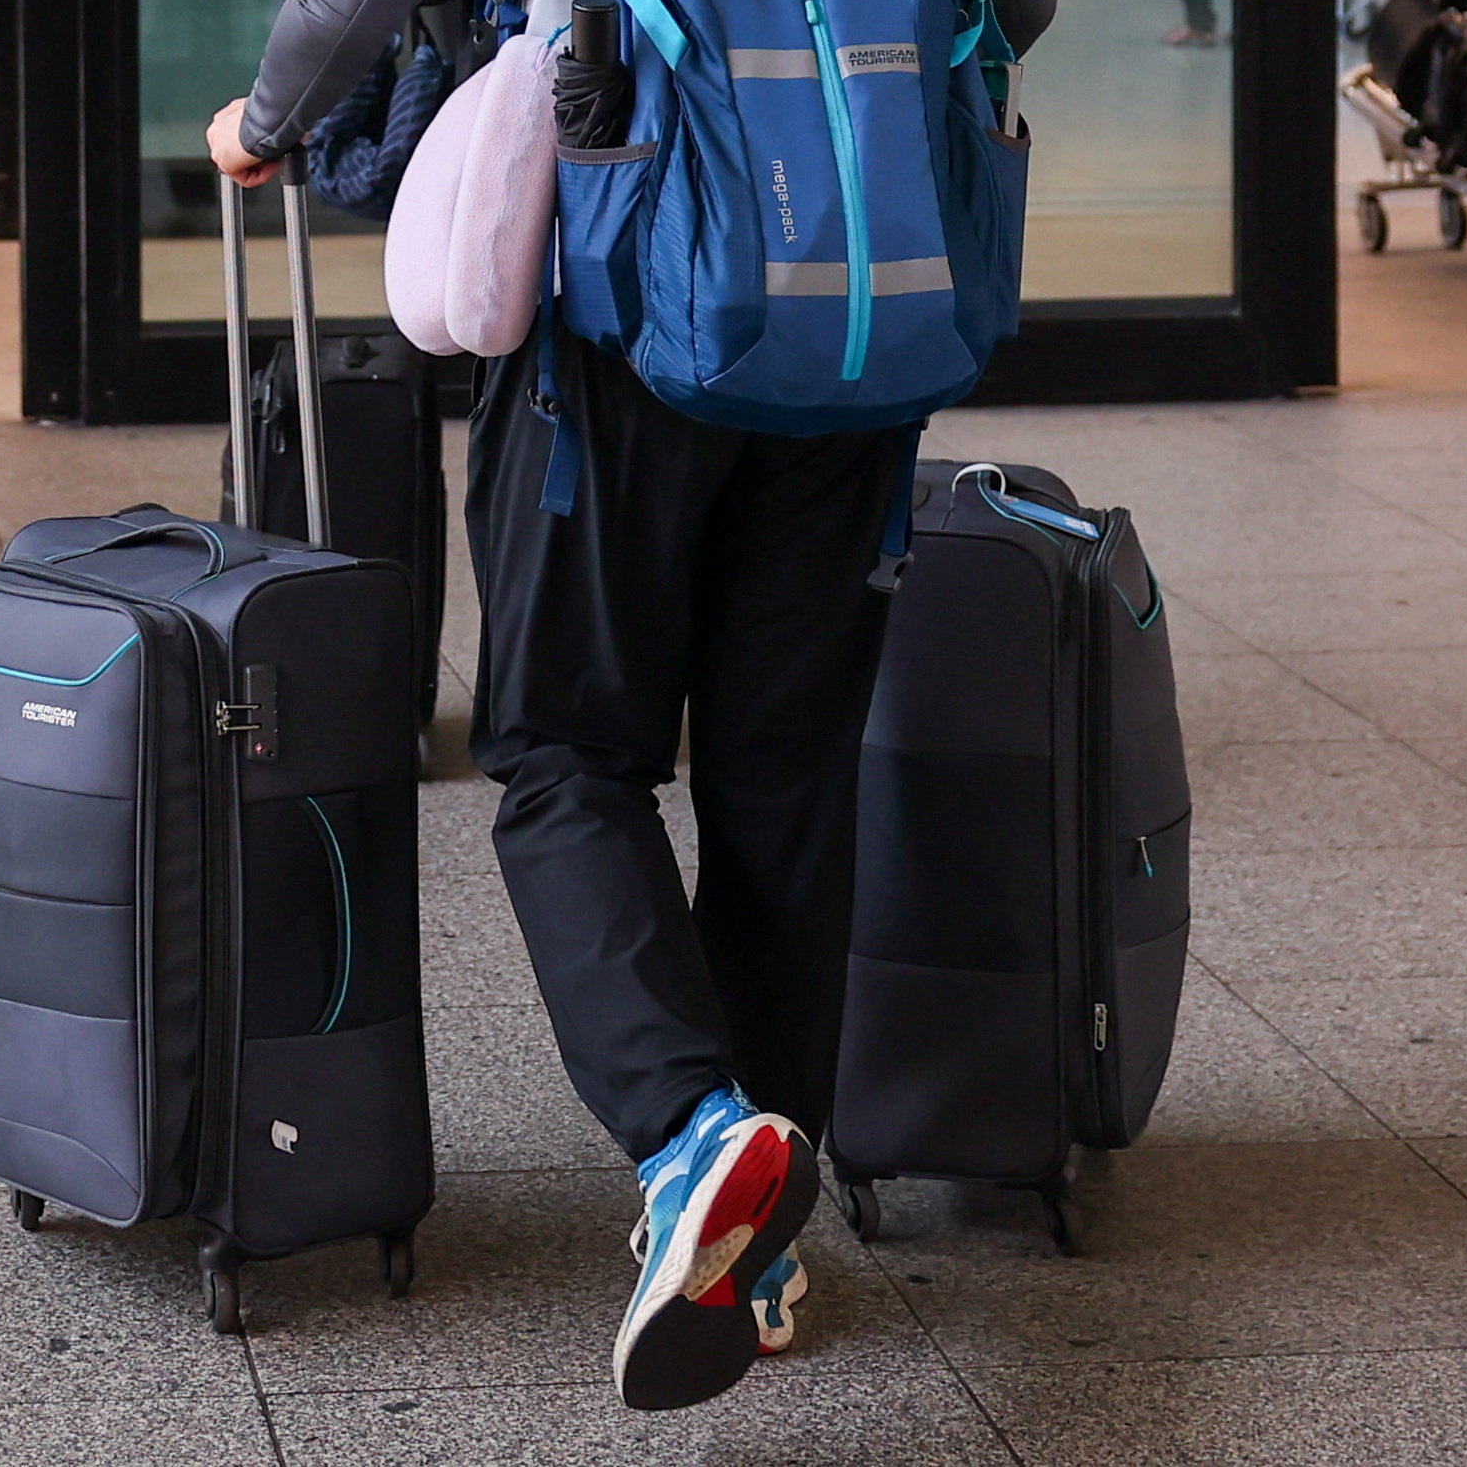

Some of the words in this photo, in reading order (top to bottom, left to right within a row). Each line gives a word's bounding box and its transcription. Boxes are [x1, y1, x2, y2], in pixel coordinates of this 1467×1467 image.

[848, 49, 915, 59] AMERICAN
[848, 56, 916, 67] TOURISTER
[771, 159, 799, 244] mega-pack
[22, 702, 77, 718] AMERICAN
[22, 710, 75, 727] TOURISTER
